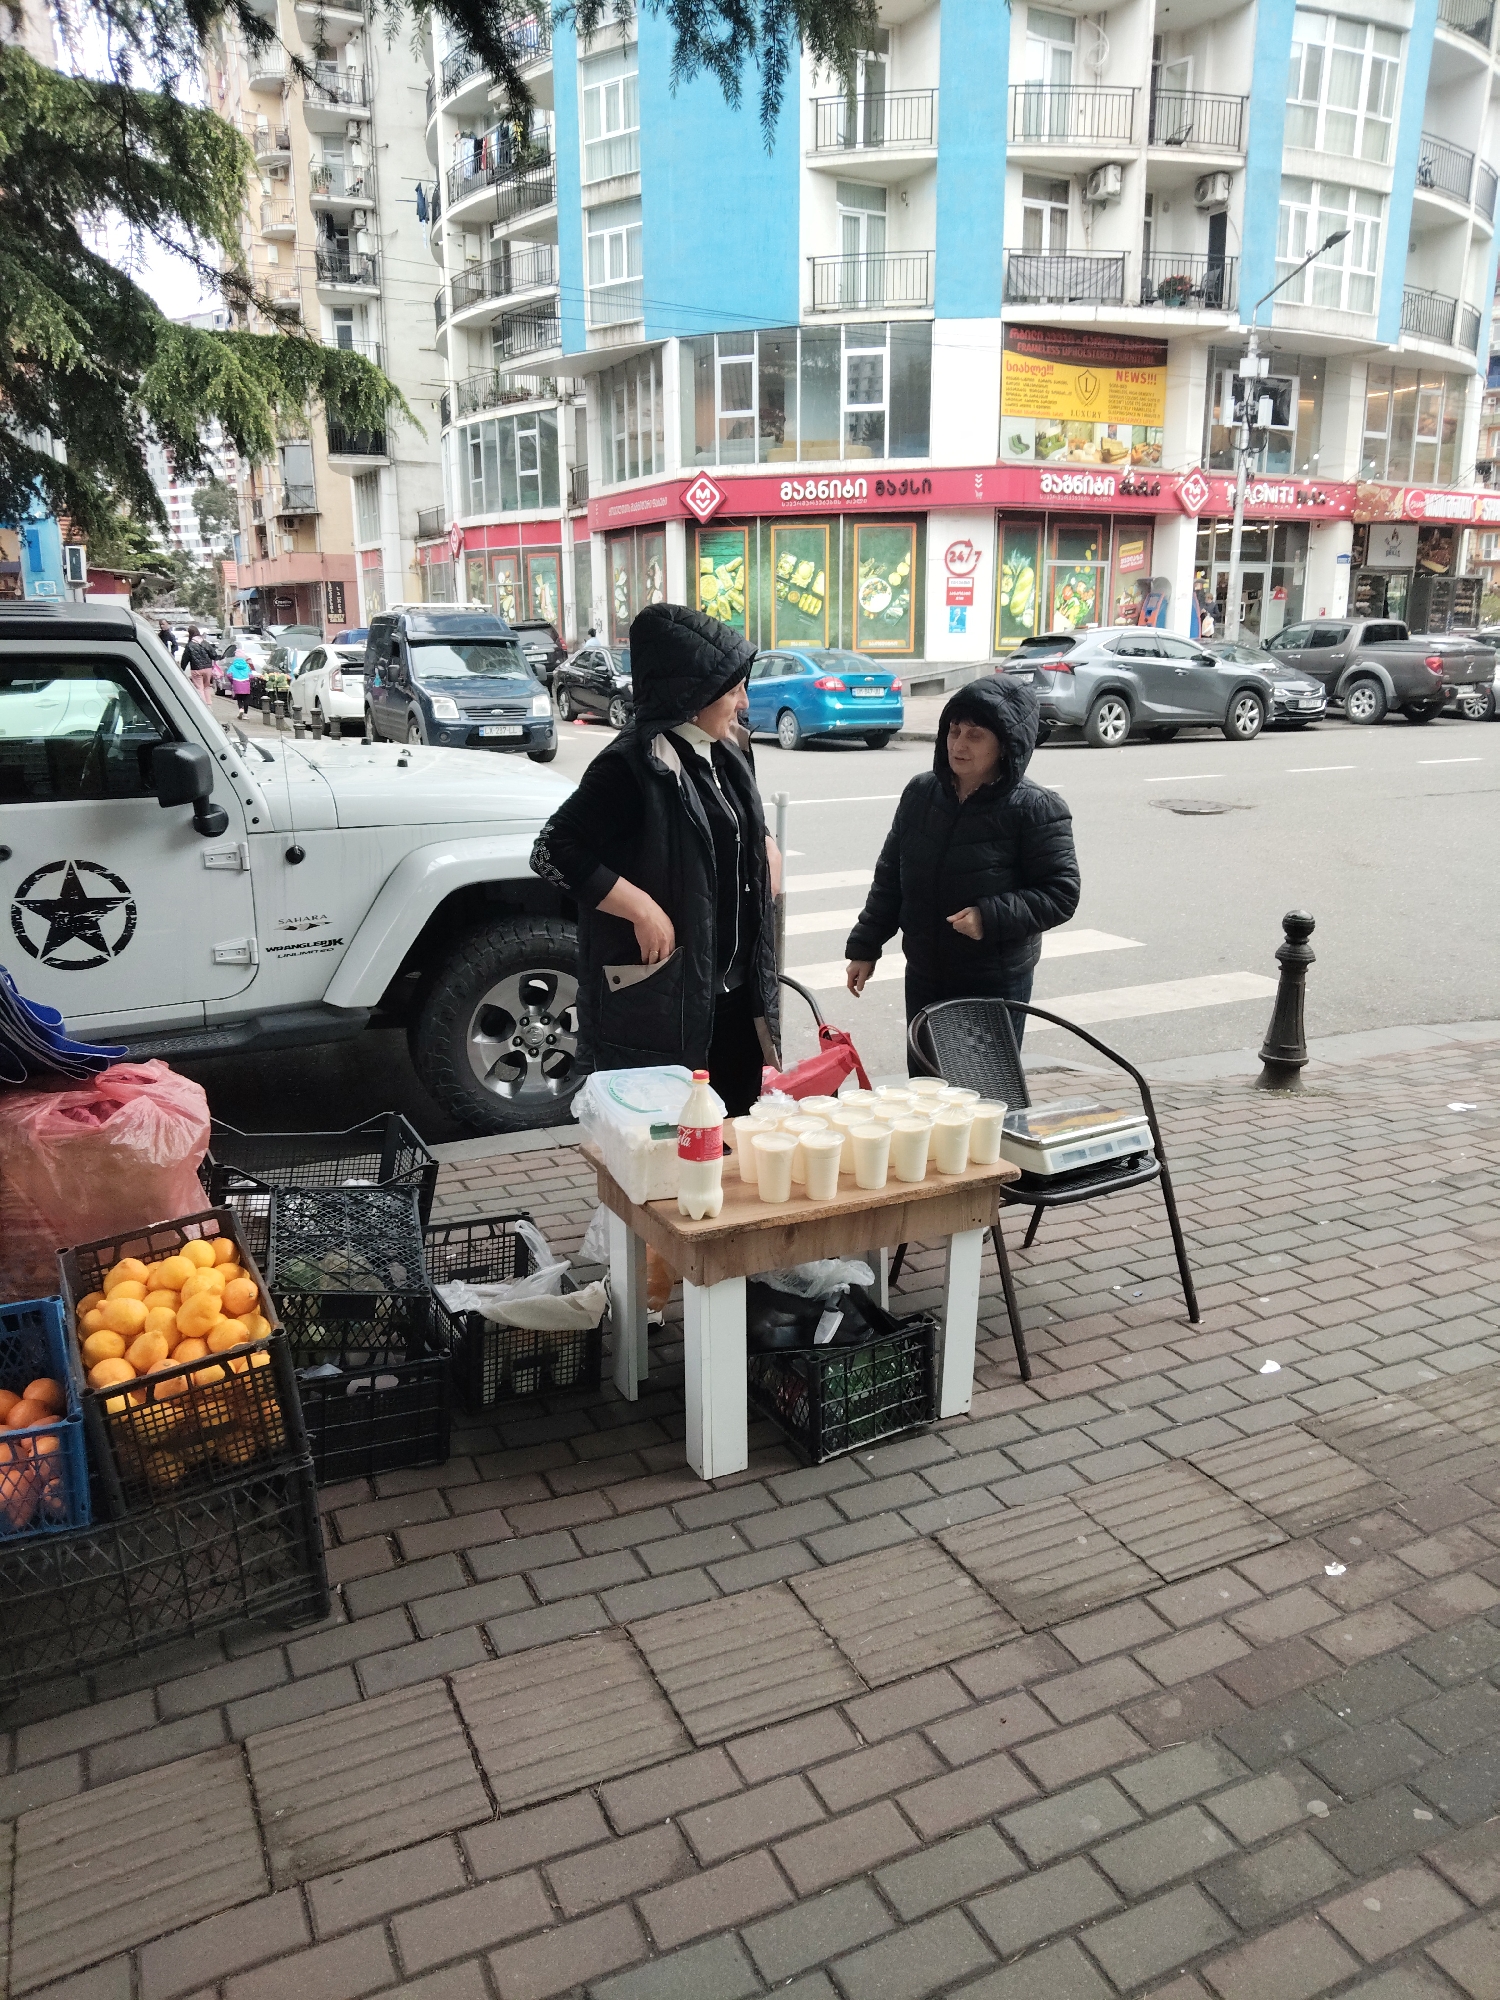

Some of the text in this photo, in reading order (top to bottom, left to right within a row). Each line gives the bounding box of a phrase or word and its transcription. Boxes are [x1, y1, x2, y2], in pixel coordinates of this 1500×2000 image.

[1017, 342, 1060, 355] FRAMELESS
[1006, 360, 1054, 377] სიახლე!!!
[1116, 370, 1157, 385] NEWS!!!
[1070, 409, 1102, 419] LUXURY
[780, 477, 932, 500] მაგნიტი მაქსი
[1040, 473, 1115, 496] მაგნიტი
[949, 547, 982, 563] 24/7
[278, 914, 328, 925] SAHARA
[277, 948, 335, 958] UNLIMITED
